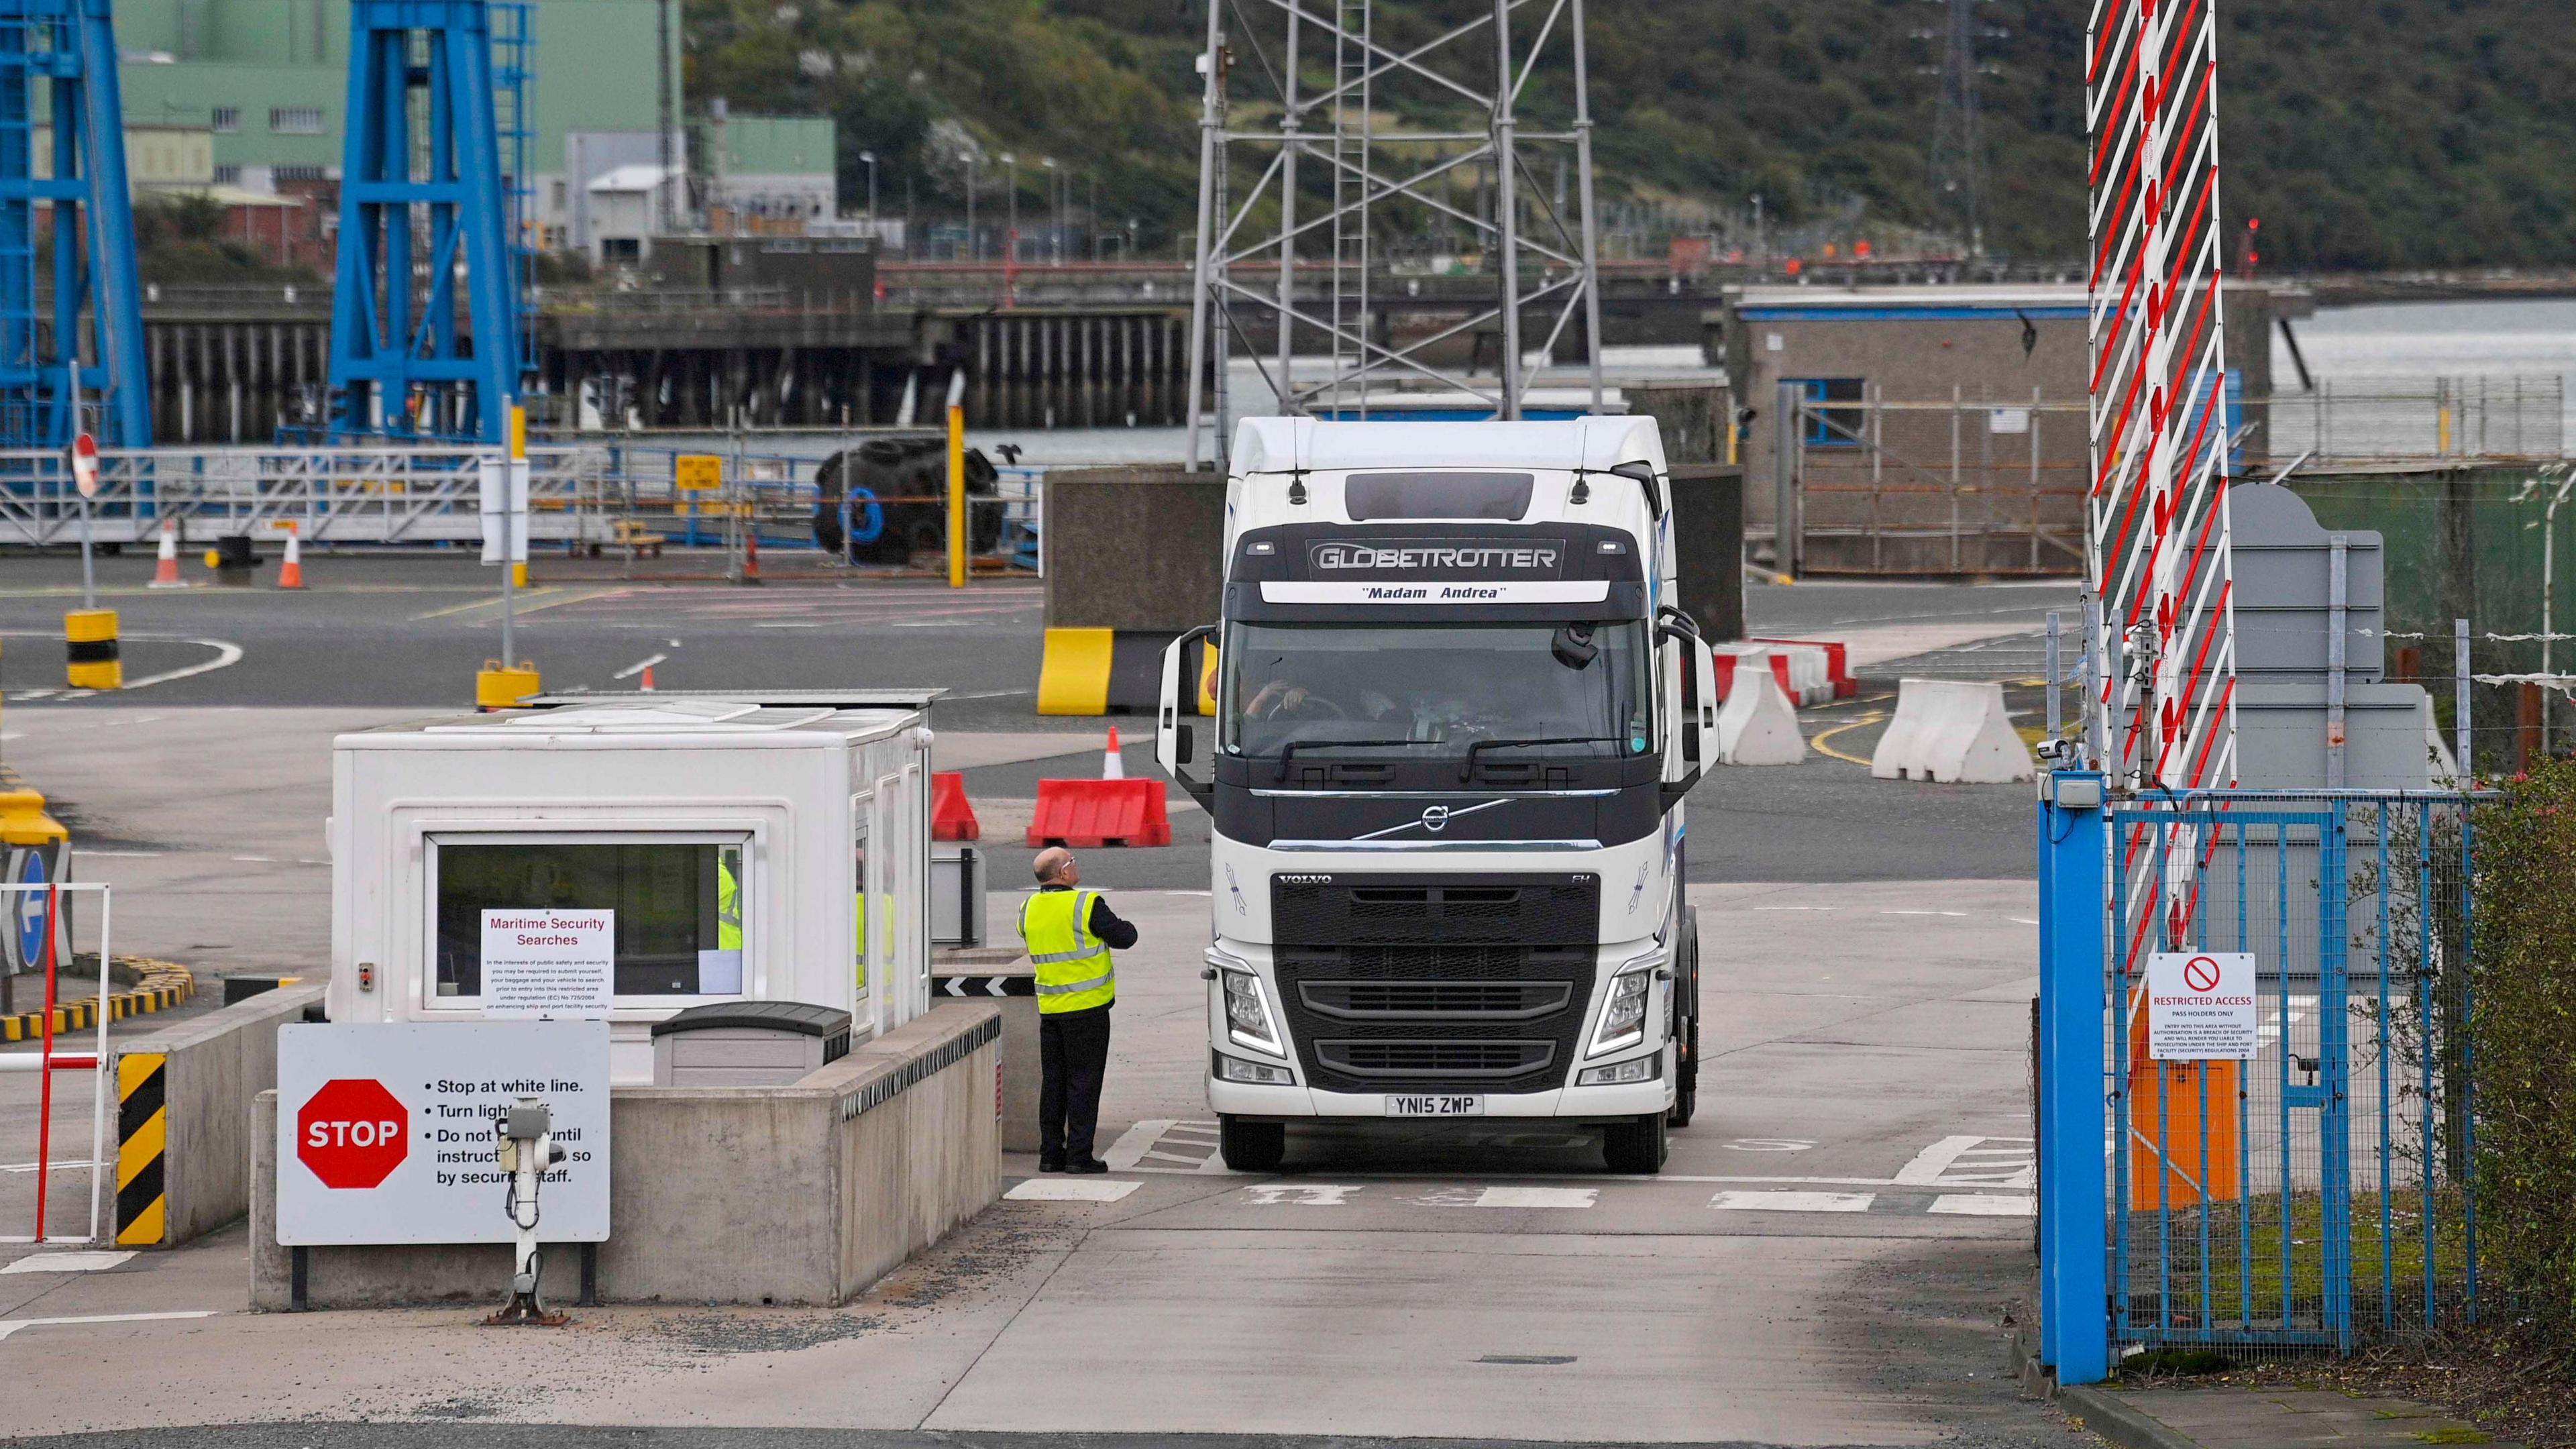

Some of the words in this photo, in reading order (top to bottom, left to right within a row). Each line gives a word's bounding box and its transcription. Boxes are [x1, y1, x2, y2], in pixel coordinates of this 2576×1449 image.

[1318, 547, 1557, 570] GLOBETROTTER
[1278, 875, 1332, 883] VOLVO
[1571, 875, 1590, 883] FH
[490, 918, 546, 929] Maritime
[551, 918, 604, 931] Security
[517, 934, 578, 945] Searches
[2153, 997, 2212, 1006] RESTRICTED
[2215, 997, 2252, 1006] ACCESS
[437, 1080, 475, 1095] Stop
[481, 1081, 496, 1093] at
[501, 1079, 545, 1092] white
[551, 1079, 584, 1092] line.
[437, 1105, 473, 1118] Turn
[1396, 1097, 1434, 1114] YN15
[1440, 1097, 1473, 1113] ZWP
[307, 1120, 398, 1147] STOP
[437, 1129, 460, 1142] Do
[466, 1130, 492, 1142] not
[437, 1150, 500, 1163] instruct
[572, 1152, 591, 1161] so
[437, 1171, 456, 1187] by
